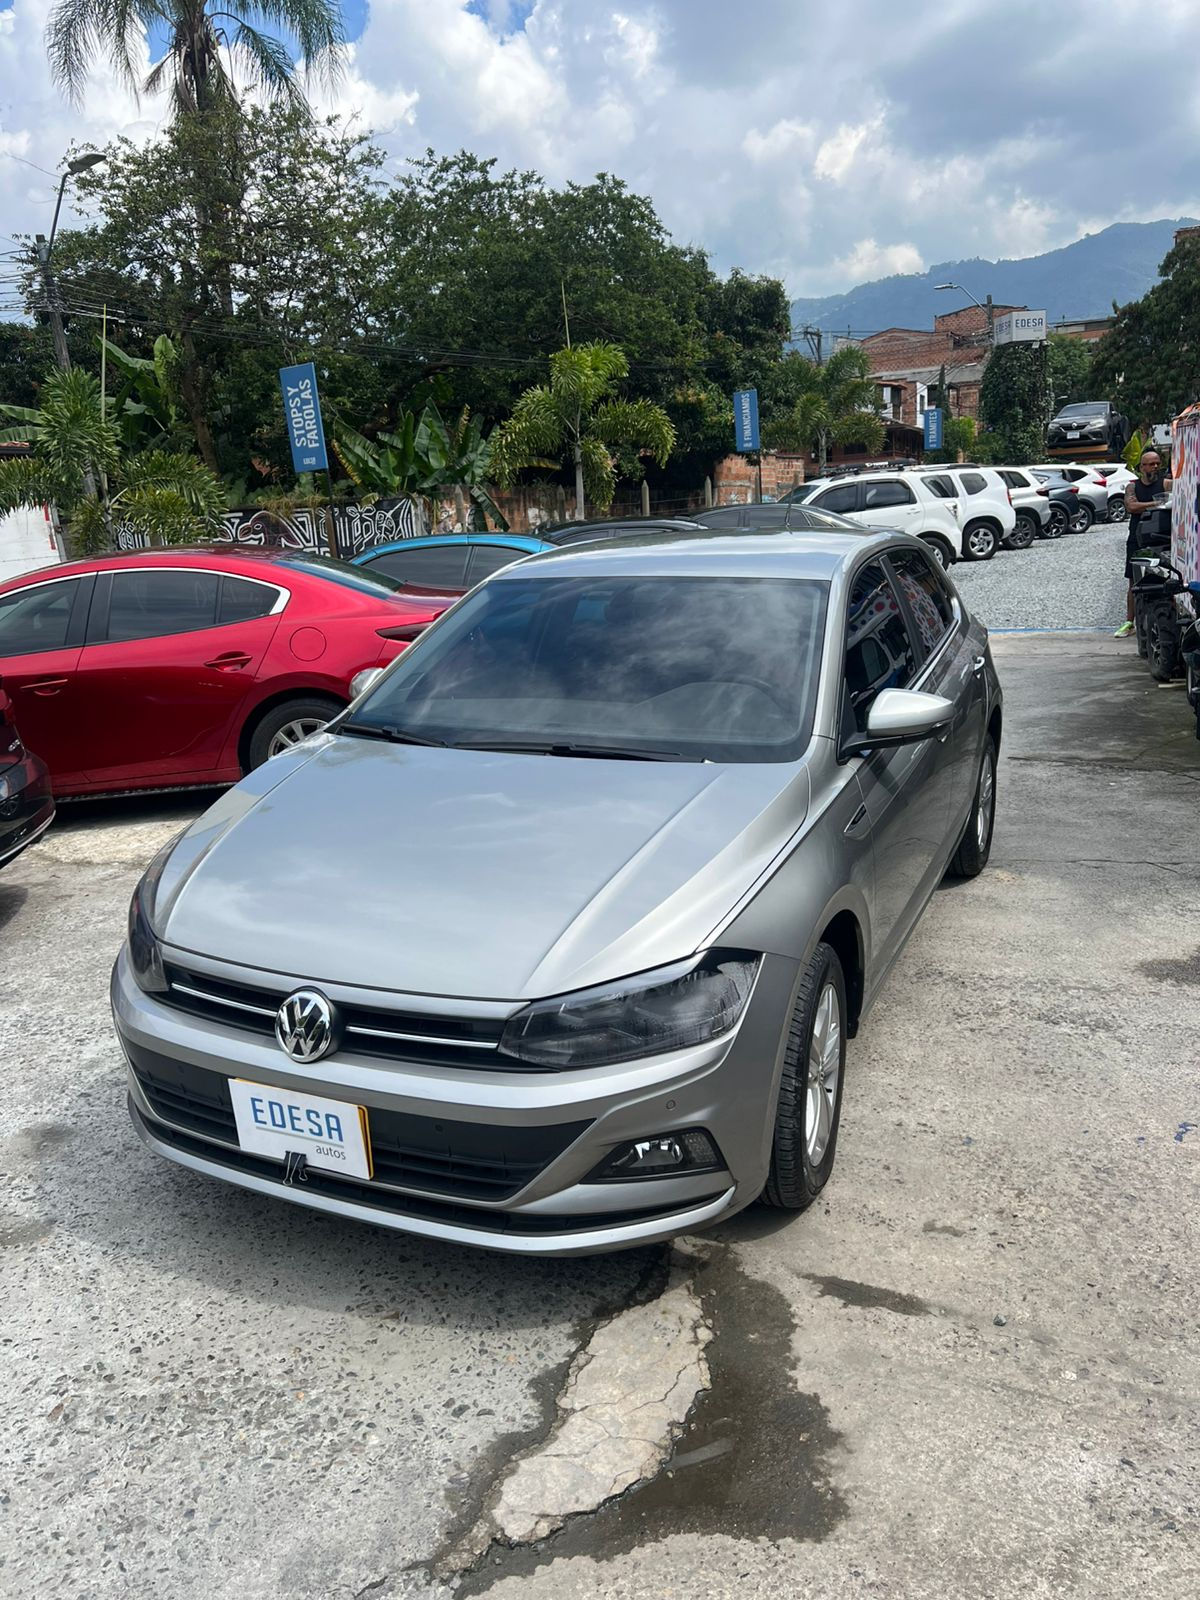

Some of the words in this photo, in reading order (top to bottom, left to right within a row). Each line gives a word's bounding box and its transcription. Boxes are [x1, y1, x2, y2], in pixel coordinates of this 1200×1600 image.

[1015, 318, 1043, 328] EDESA
[299, 379, 320, 449] FAROLAS
[741, 393, 752, 440] FINANCIAMOS
[250, 1096, 344, 1143] EDESA
[315, 1144, 347, 1161] autos
